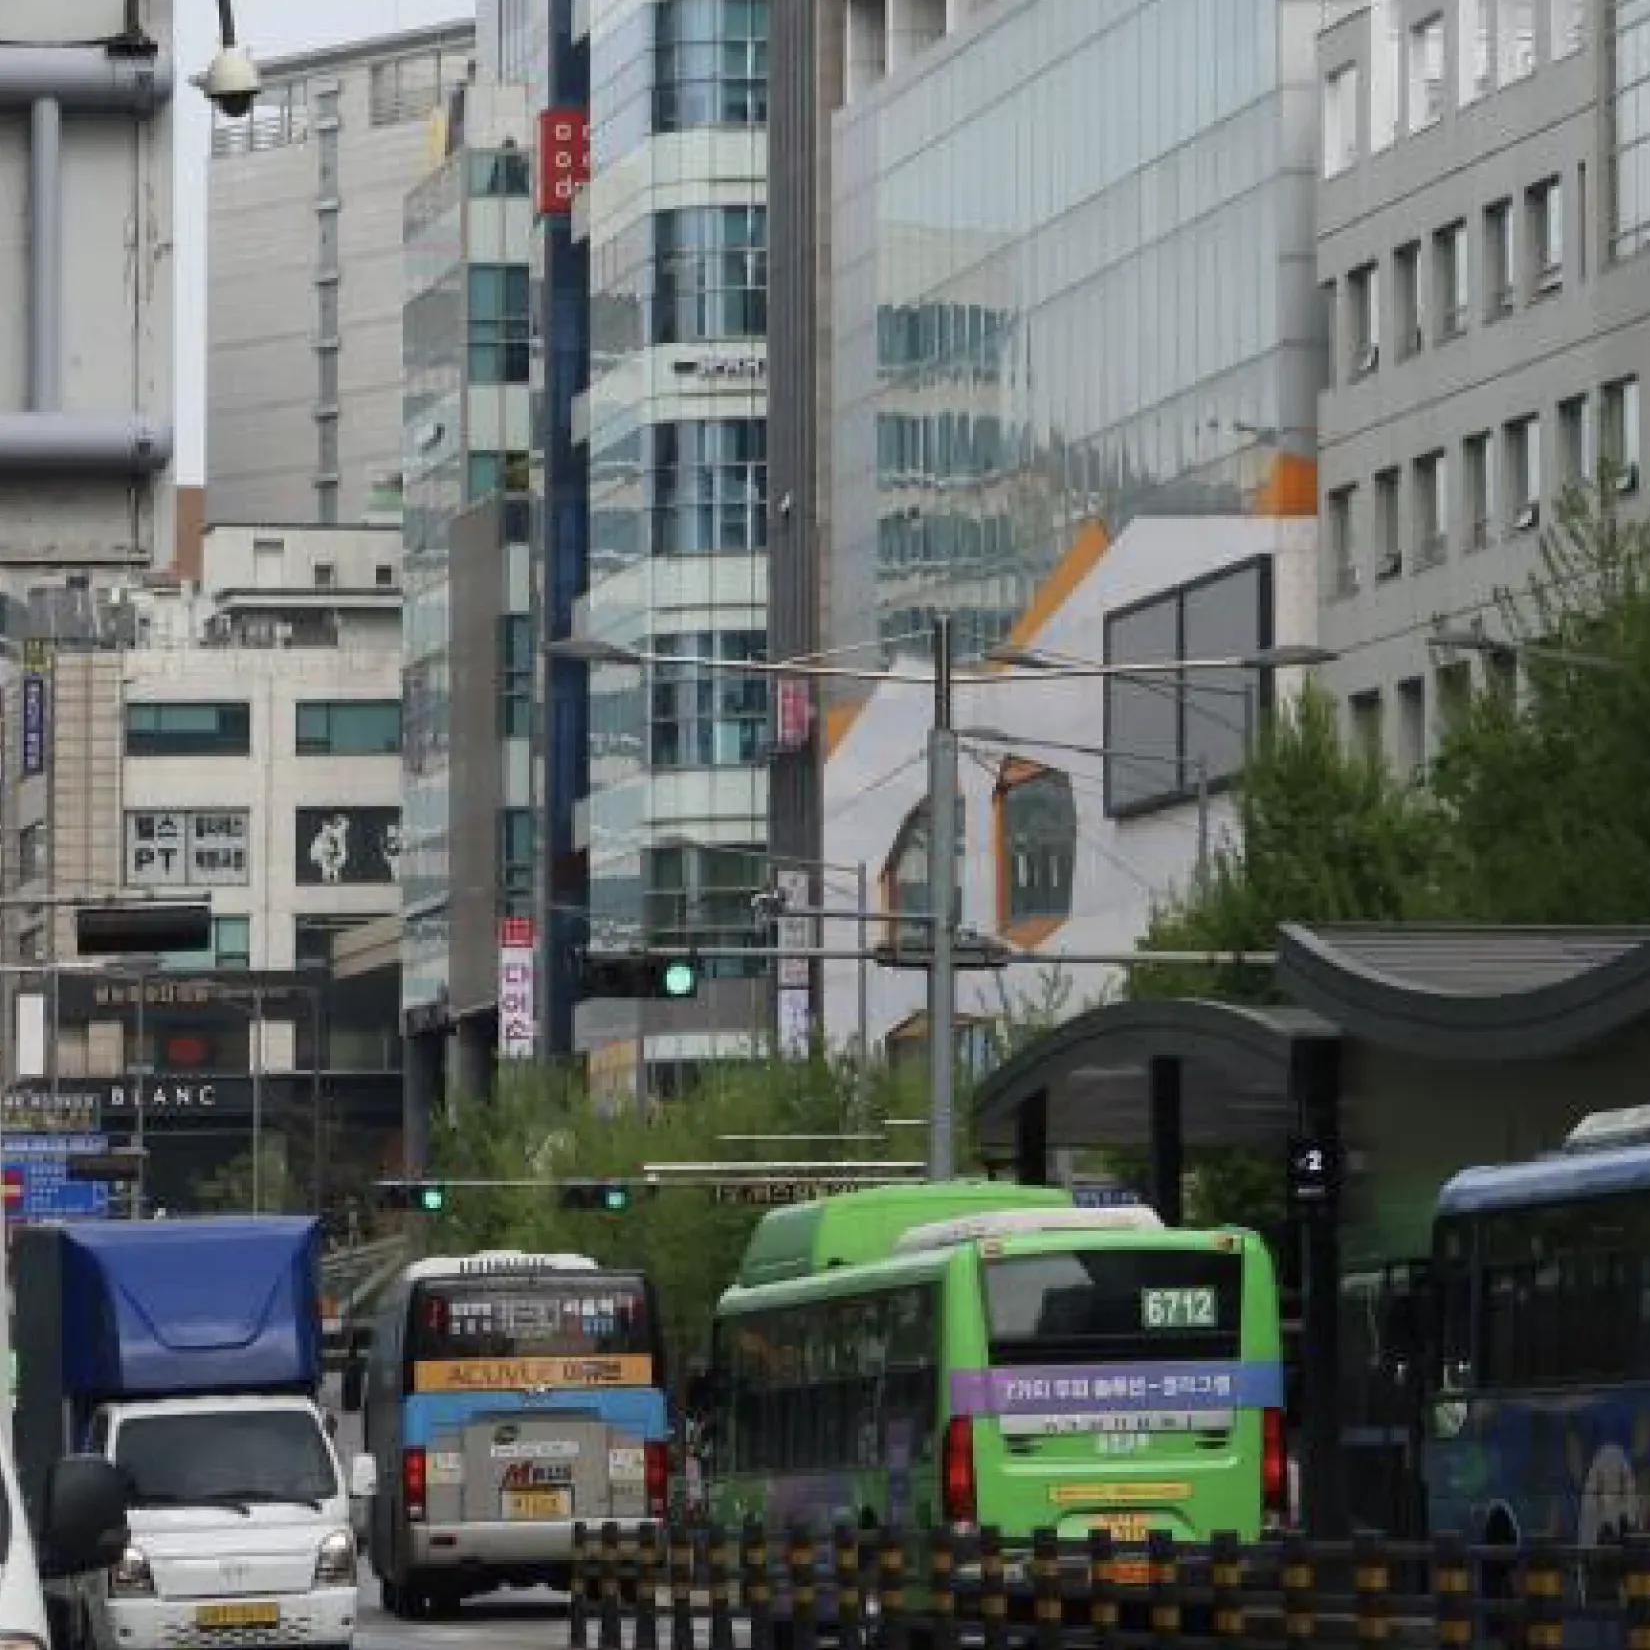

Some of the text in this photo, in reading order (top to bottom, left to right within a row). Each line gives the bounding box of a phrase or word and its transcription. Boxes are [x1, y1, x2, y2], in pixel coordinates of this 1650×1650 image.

[134, 848, 177, 874] PT
[111, 1085, 216, 1106] BLANC
[1145, 1292, 1215, 1326] 6712
